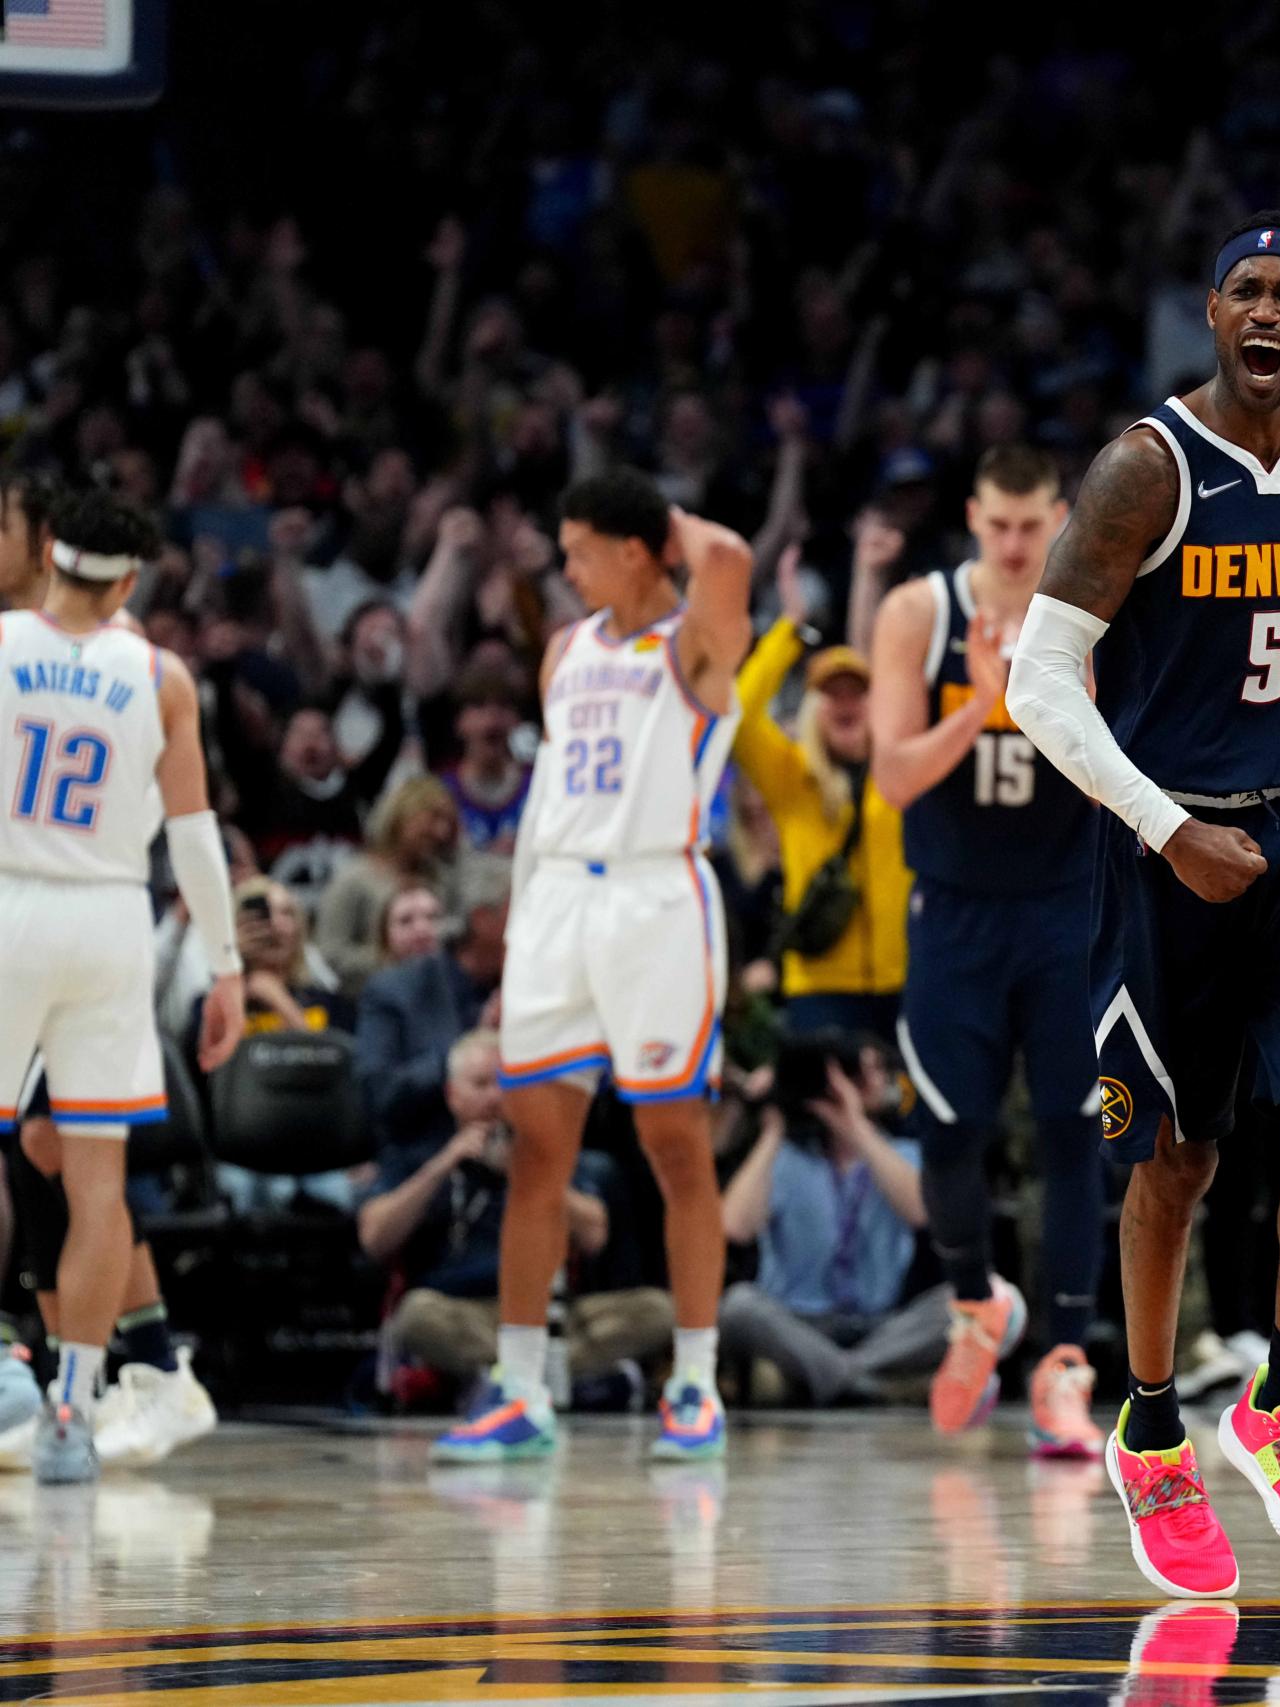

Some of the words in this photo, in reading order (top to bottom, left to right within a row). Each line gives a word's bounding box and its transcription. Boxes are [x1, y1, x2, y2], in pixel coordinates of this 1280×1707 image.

[12, 660, 101, 700] WATERS
[11, 714, 114, 836] 12
[564, 736, 624, 796] 22
[974, 733, 1036, 807] 15
